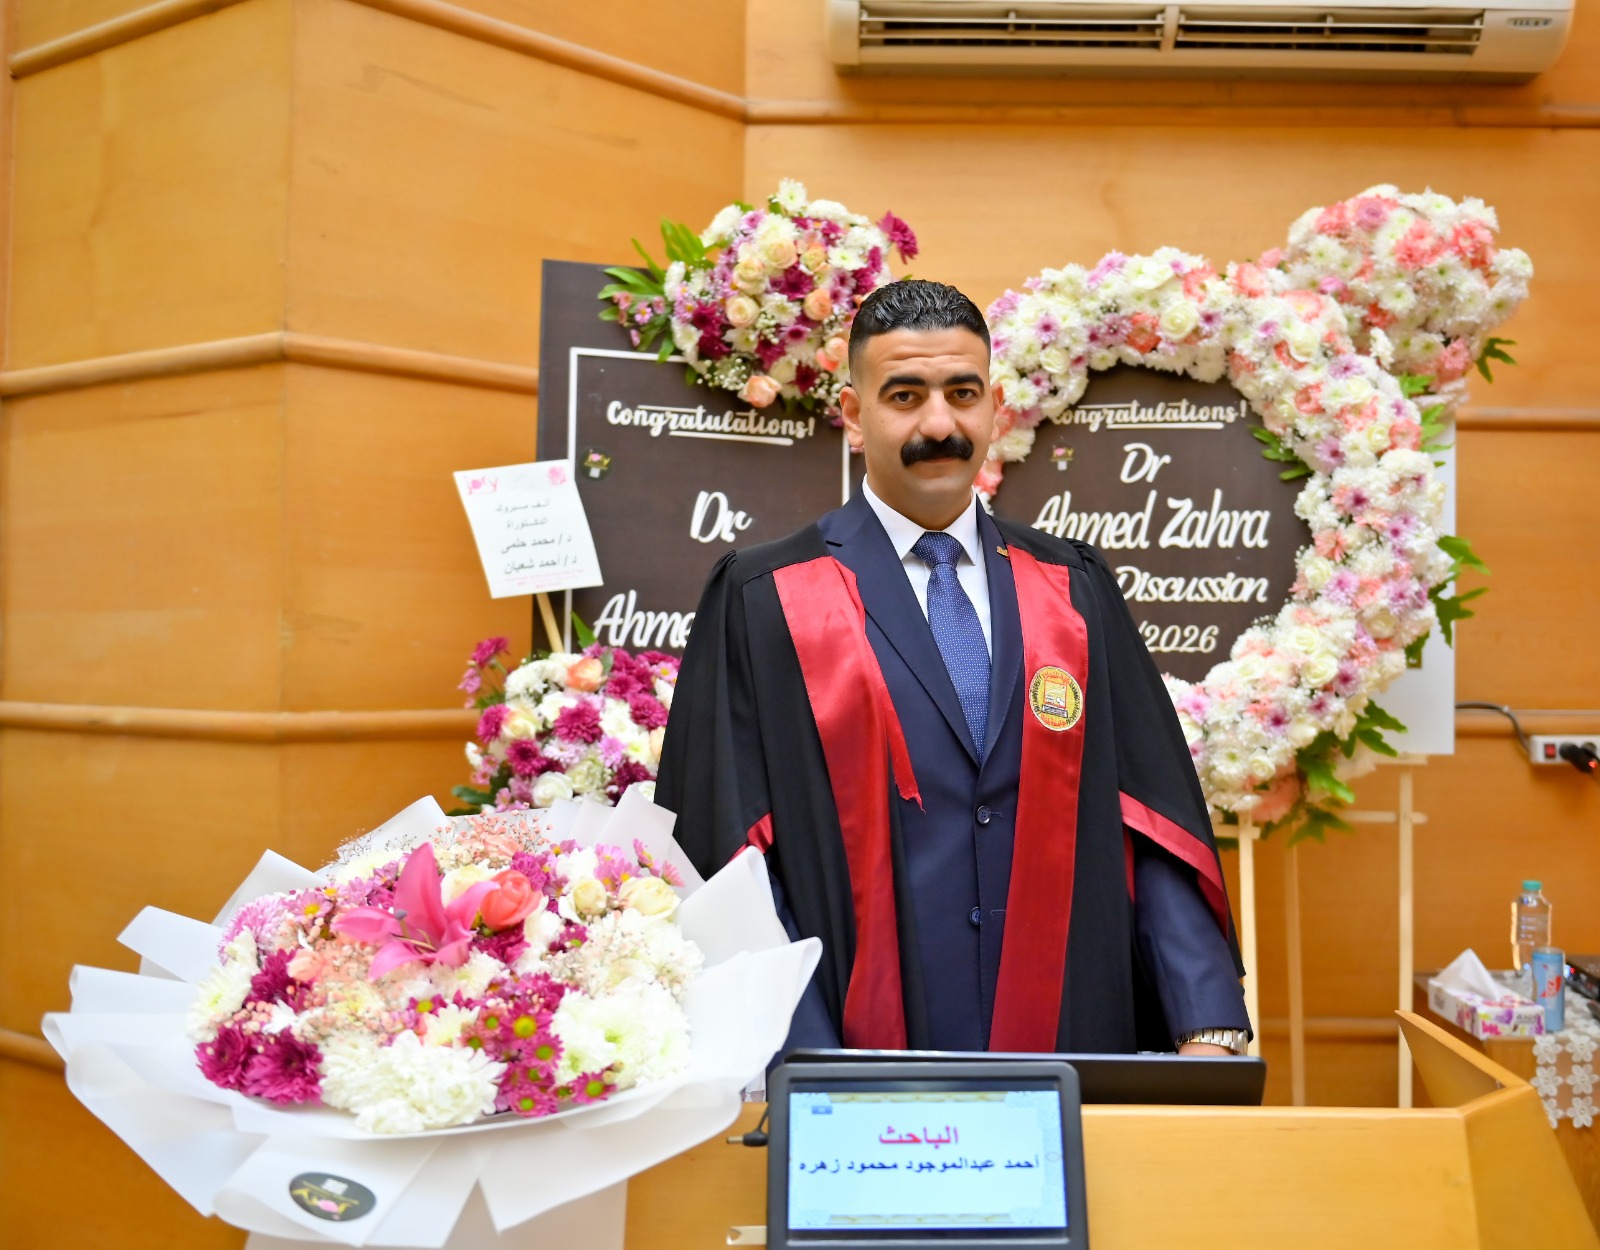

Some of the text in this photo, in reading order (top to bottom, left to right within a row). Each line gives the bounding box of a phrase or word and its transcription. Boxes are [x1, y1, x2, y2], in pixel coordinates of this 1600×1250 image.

[607, 400, 816, 439] Congratulations!
[1120, 442, 1171, 483] Dr
[689, 490, 752, 543] Dr
[1031, 488, 1271, 549] Ahmed Zahra
[1115, 565, 1269, 603] Discussion
[879, 1125, 959, 1149] الباحث
[847, 1159, 898, 1173] محمود
